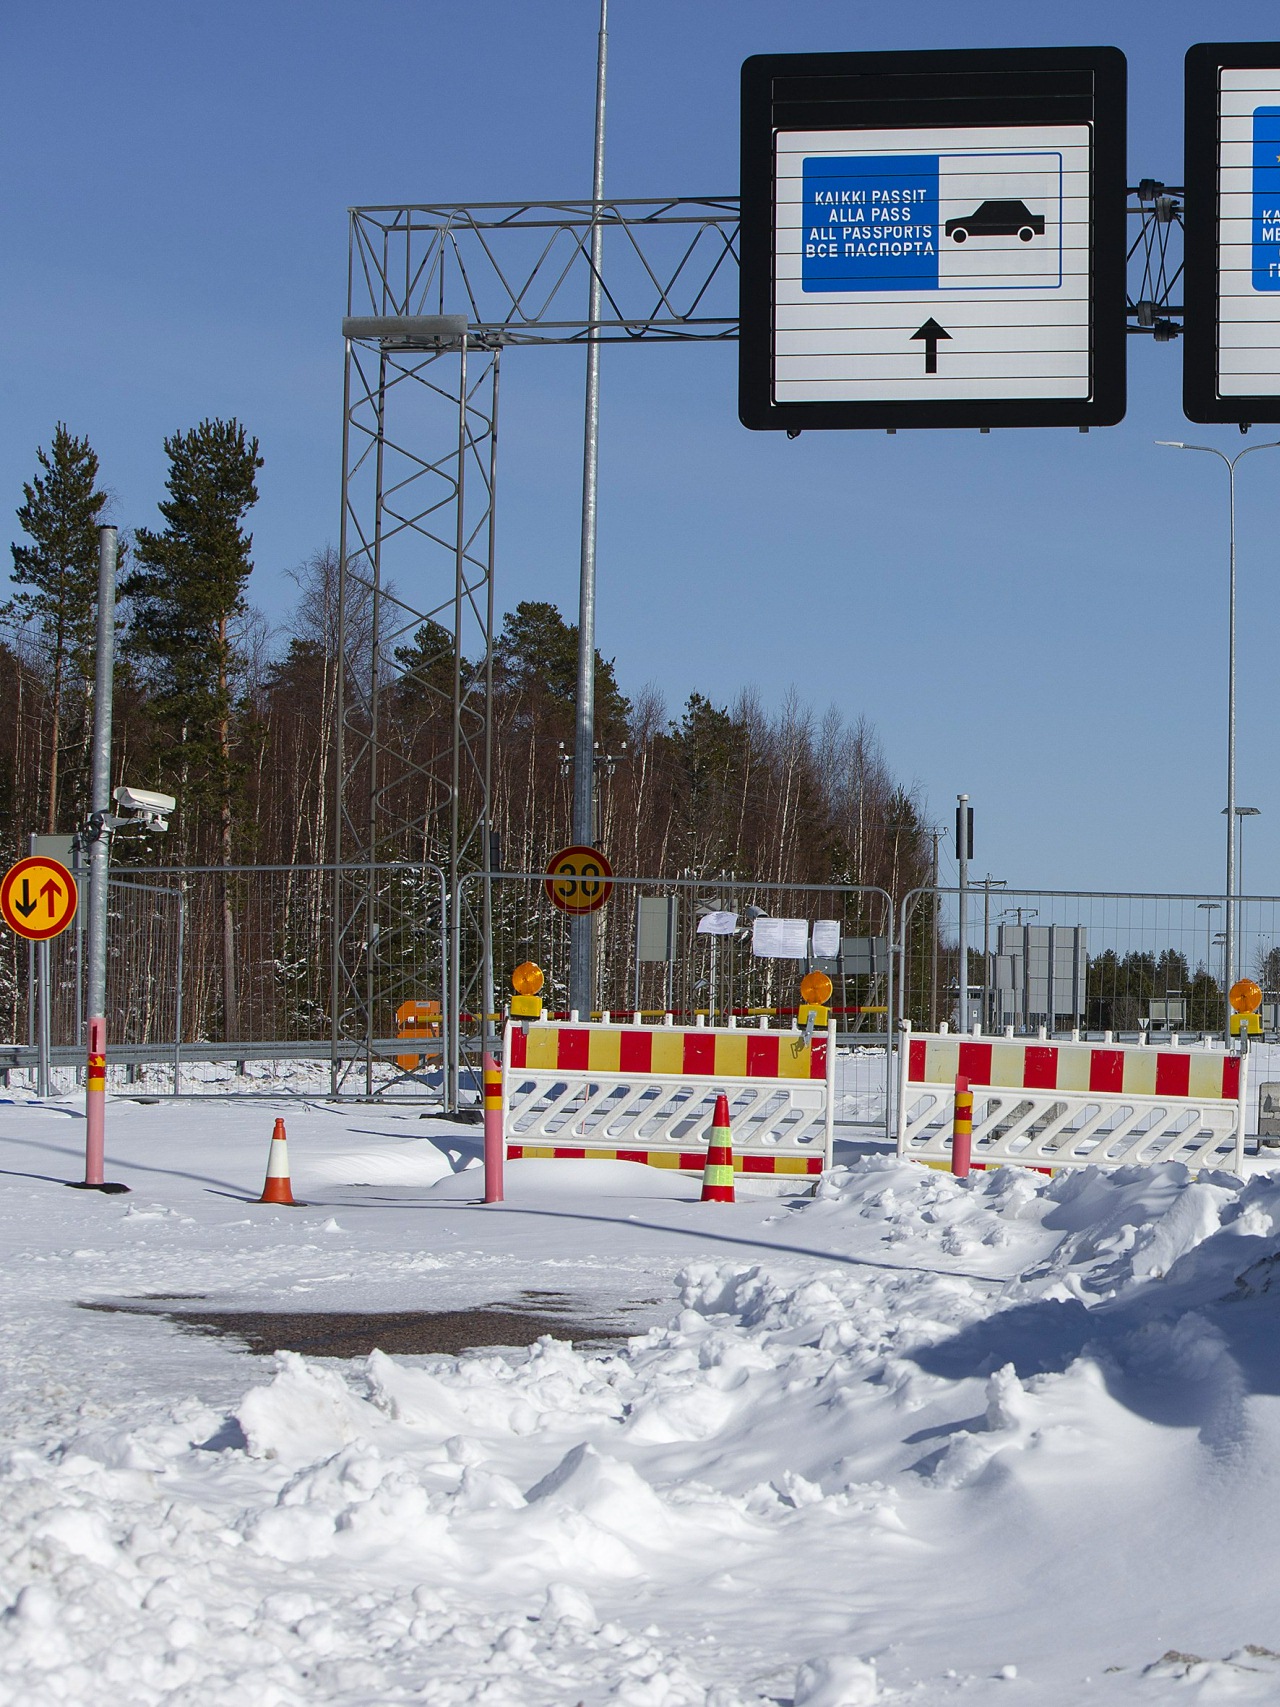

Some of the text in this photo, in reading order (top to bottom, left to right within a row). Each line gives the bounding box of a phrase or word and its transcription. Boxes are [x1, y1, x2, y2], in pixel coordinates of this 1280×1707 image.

[815, 189, 927, 206] KAIKKI PASSIT
[829, 207, 911, 222] ALLA PASS
[809, 225, 932, 241] ALL PASSPORTS
[806, 242, 935, 258] ВСЕ ПАСПОРТА
[558, 863, 600, 897] 30
